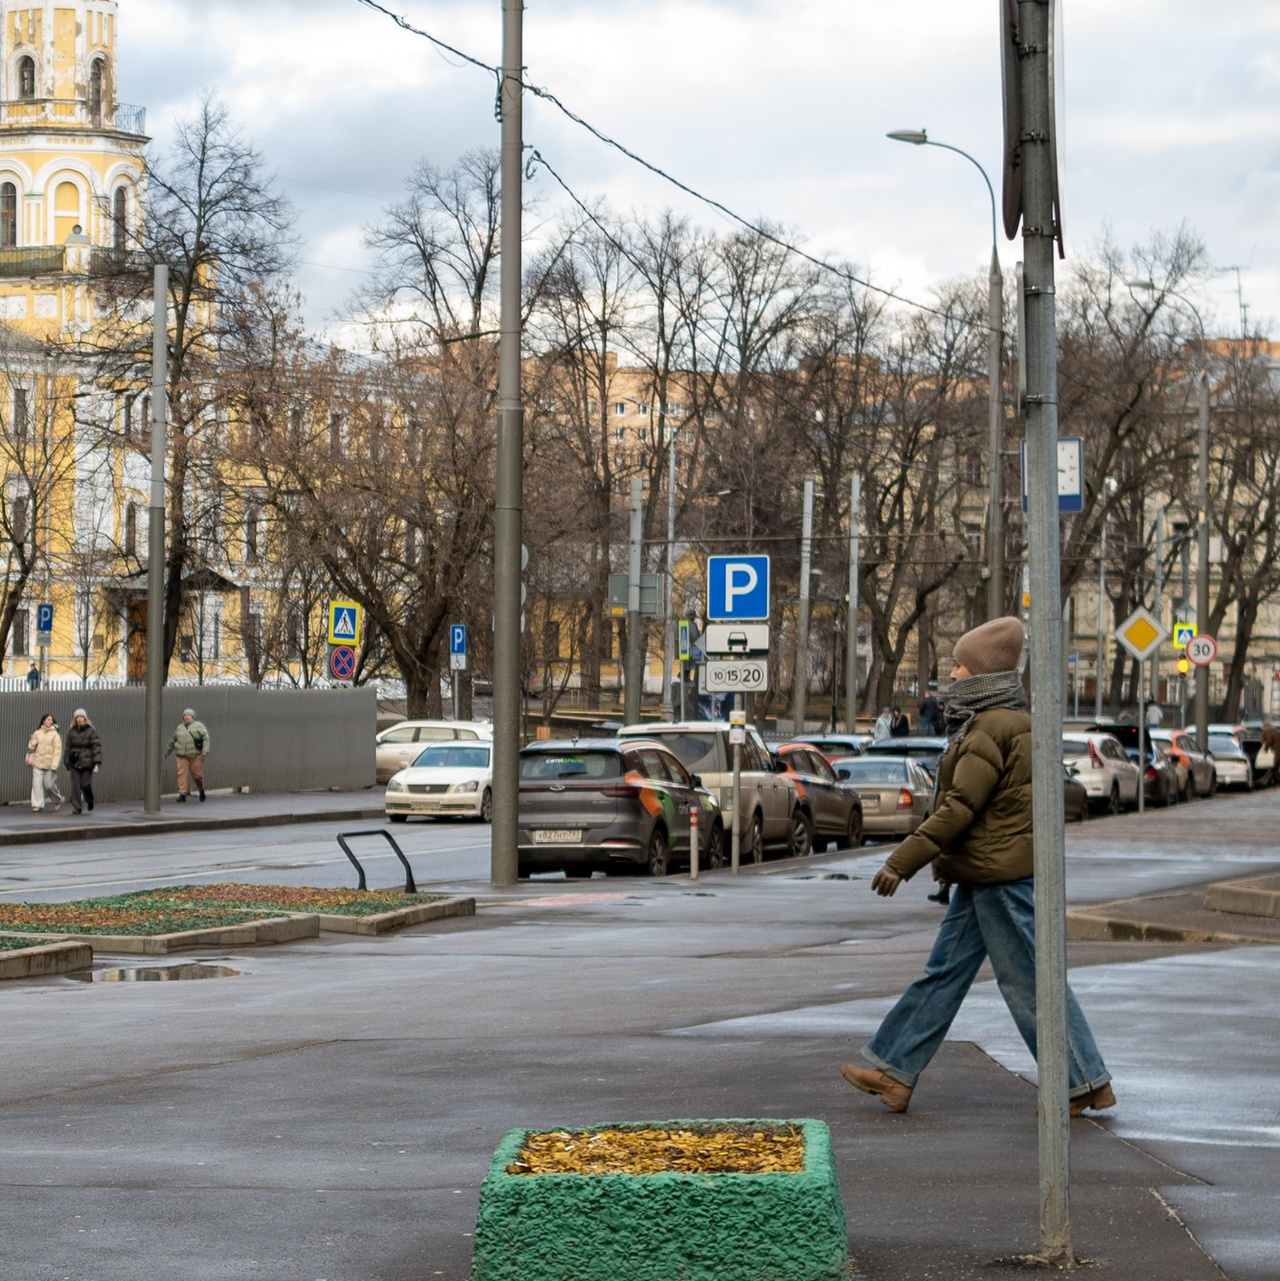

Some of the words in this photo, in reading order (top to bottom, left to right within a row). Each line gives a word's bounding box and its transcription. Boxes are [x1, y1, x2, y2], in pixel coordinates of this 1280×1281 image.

[725, 563, 758, 613] P
[40, 607, 51, 629] P
[454, 628, 463, 651] P
[1192, 644, 1210, 657] 30
[714, 671, 723, 680] 10
[727, 670, 738, 681] 15
[742, 669, 761, 682] 20
